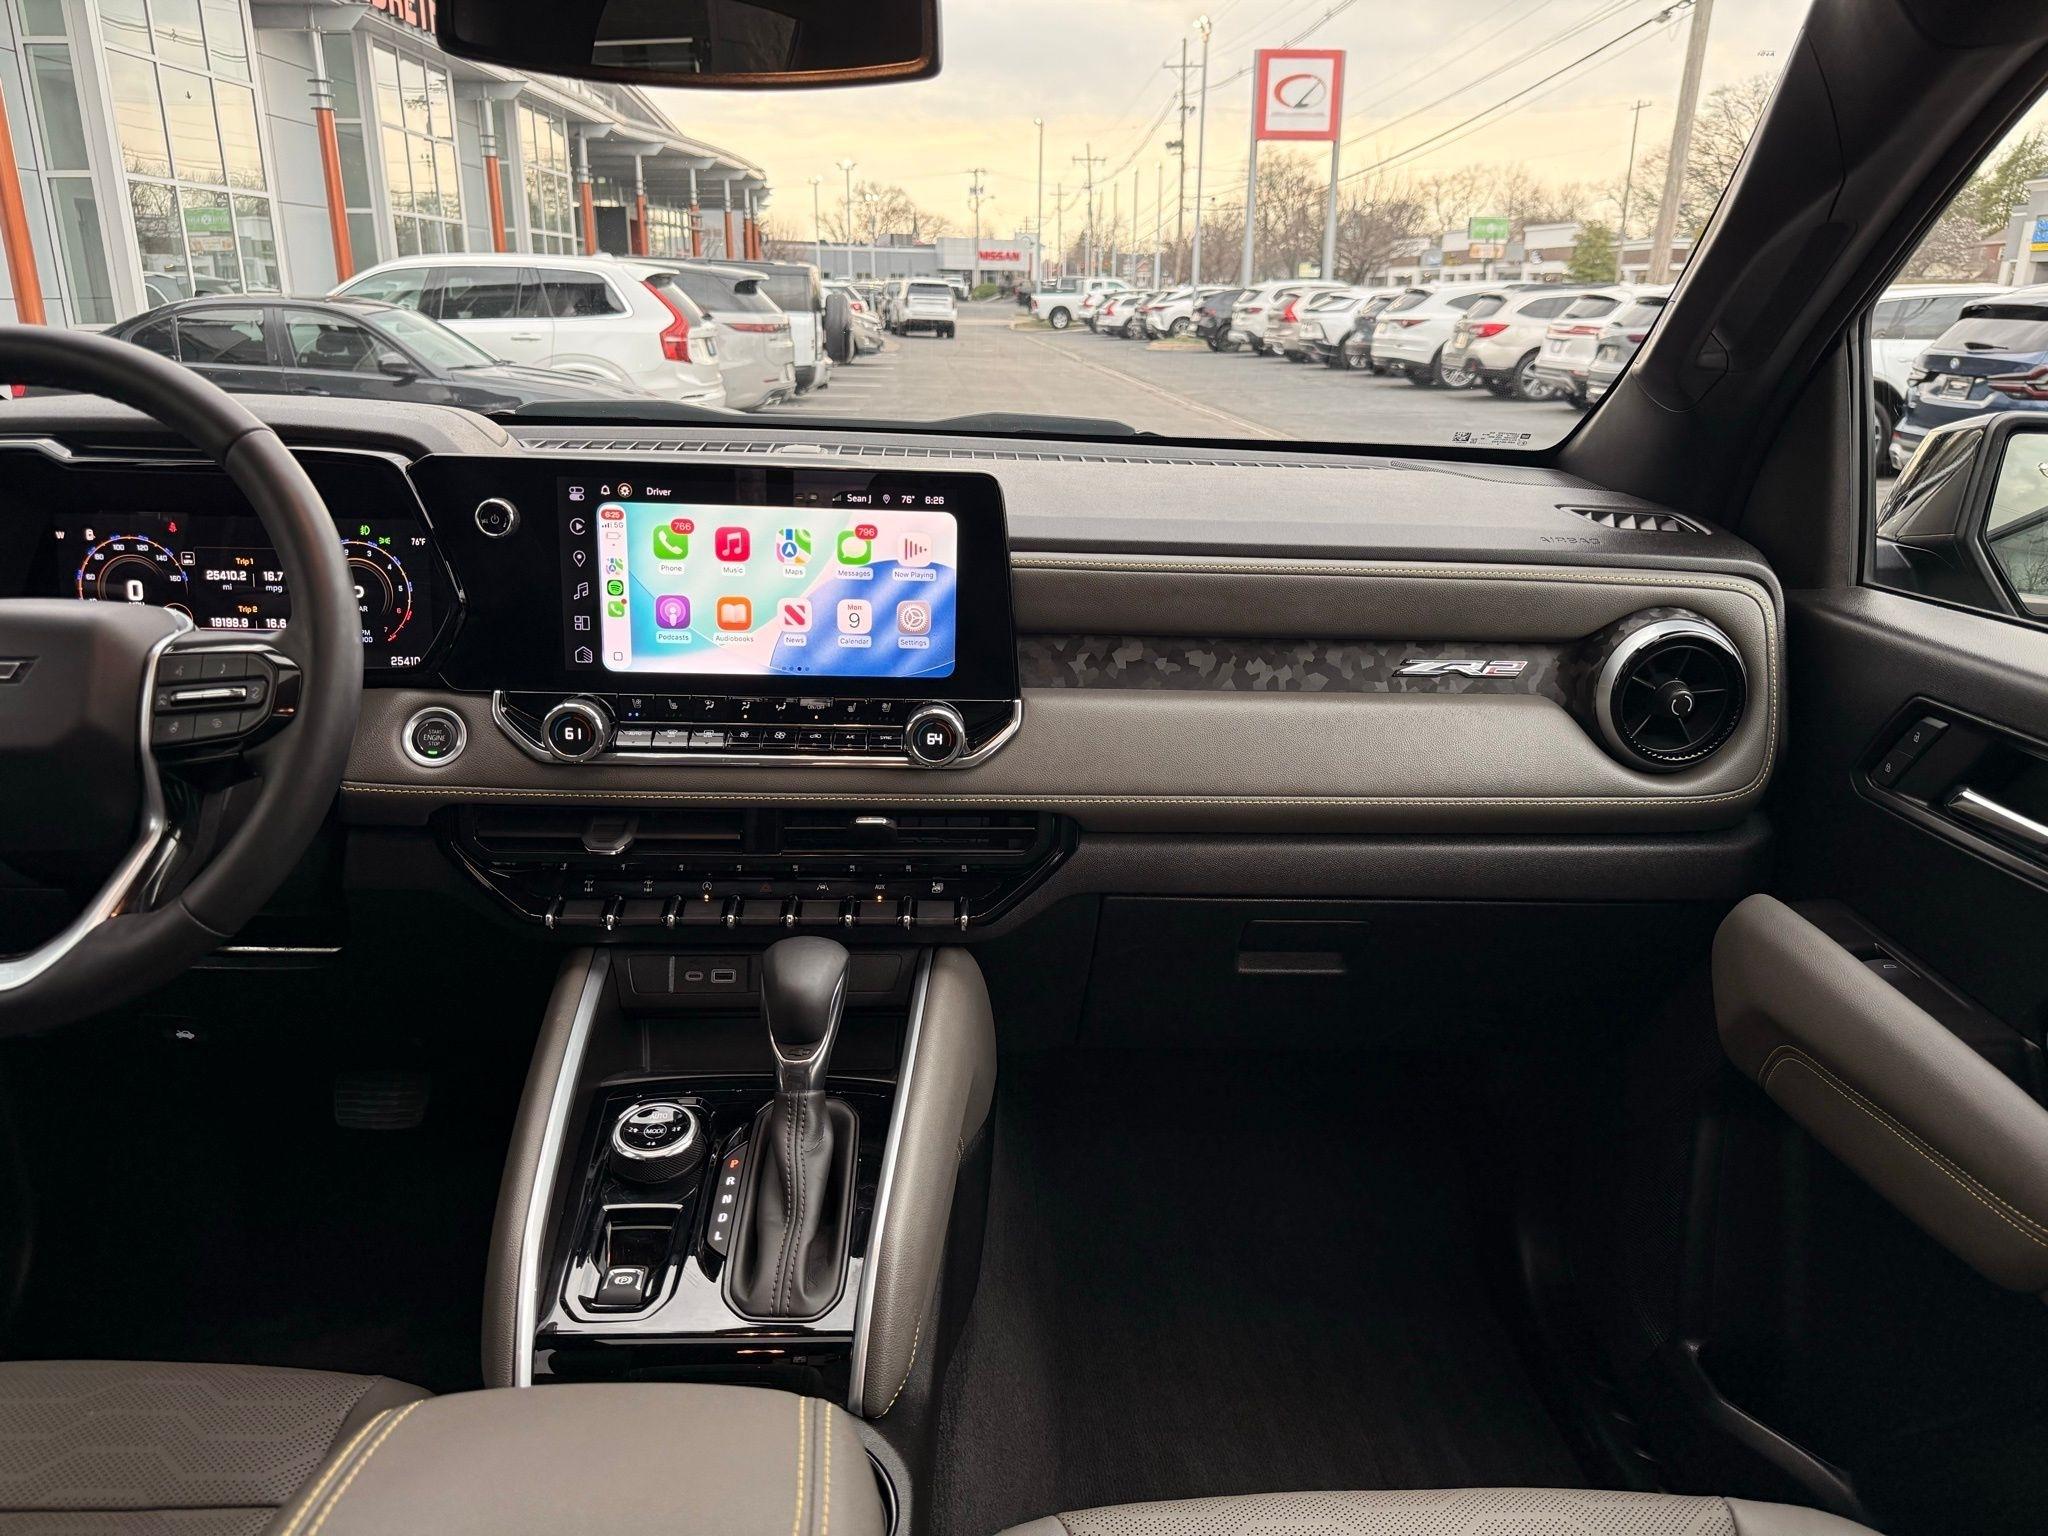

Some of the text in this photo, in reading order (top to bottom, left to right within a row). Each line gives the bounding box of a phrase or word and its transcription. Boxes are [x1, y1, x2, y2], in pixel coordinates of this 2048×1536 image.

[979, 251, 1020, 261] NISSAN
[646, 487, 671, 496] Driver
[847, 494, 867, 503] Sean
[925, 496, 944, 504] 6:26
[604, 511, 620, 519] 6:25
[674, 522, 692, 531] 766
[55, 531, 65, 539] W
[858, 527, 875, 536] 796
[411, 538, 426, 546] 76°F
[1540, 536, 1600, 545] AIRBAG
[235, 557, 250, 566] Trip
[206, 570, 247, 581] 25410.2
[263, 571, 284, 581] 16.7
[785, 568, 803, 577] Maps
[838, 570, 871, 578] Messages
[910, 572, 934, 580] Playing
[126, 580, 144, 601] 0
[265, 585, 283, 593] mpg
[238, 605, 252, 614] Trip
[211, 617, 249, 628] 19199.9
[266, 618, 287, 629] 16.6
[849, 612, 860, 628] 9
[715, 635, 754, 643] Audiobooks
[900, 639, 927, 647] Settings
[1392, 658, 1528, 679] ZR2
[564, 727, 582, 740] 61
[926, 733, 943, 746] 64
[730, 1160, 739, 1168] P
[726, 1177, 735, 1185] R
[721, 1194, 732, 1204] N
[718, 1213, 728, 1222] D
[714, 1231, 723, 1240] L
